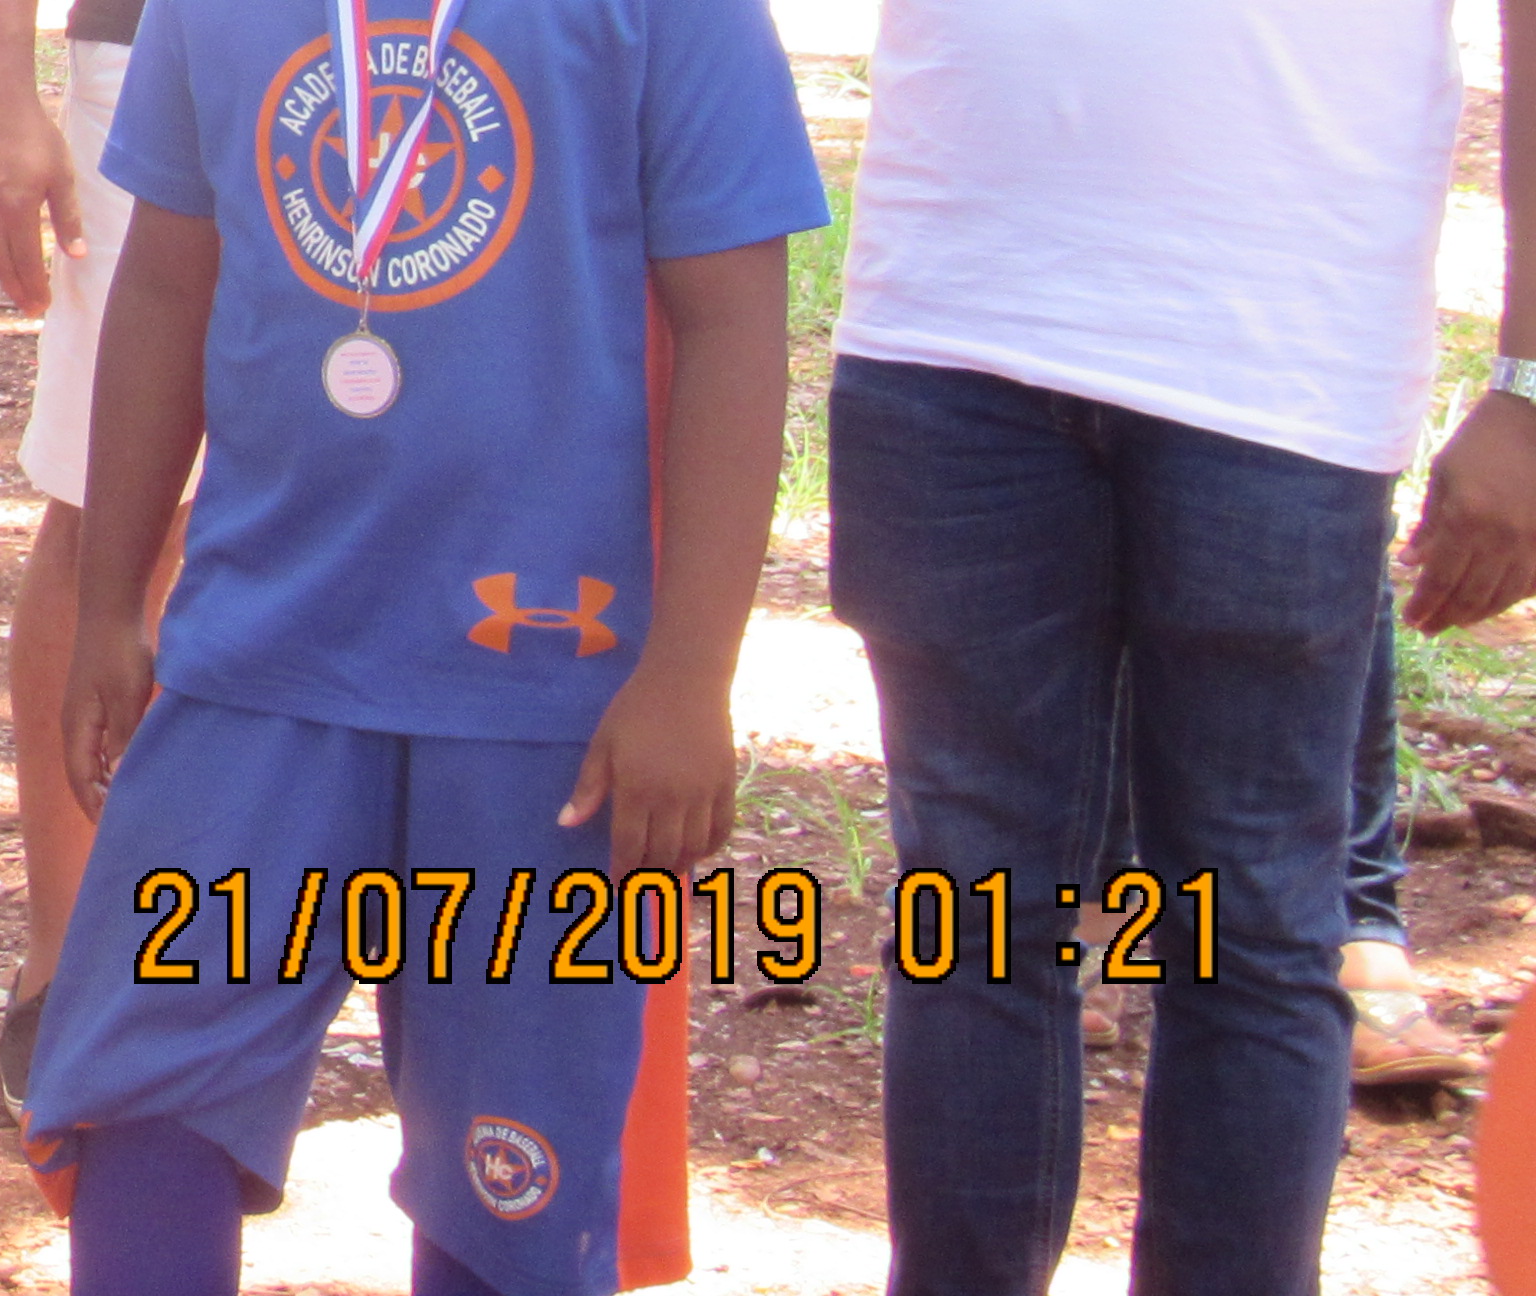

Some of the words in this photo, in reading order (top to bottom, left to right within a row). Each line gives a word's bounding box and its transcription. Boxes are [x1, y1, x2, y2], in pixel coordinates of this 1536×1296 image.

[381, 42, 411, 76] DE
[411, 45, 501, 143] BSEBALL
[387, 198, 496, 288] CORONADO
